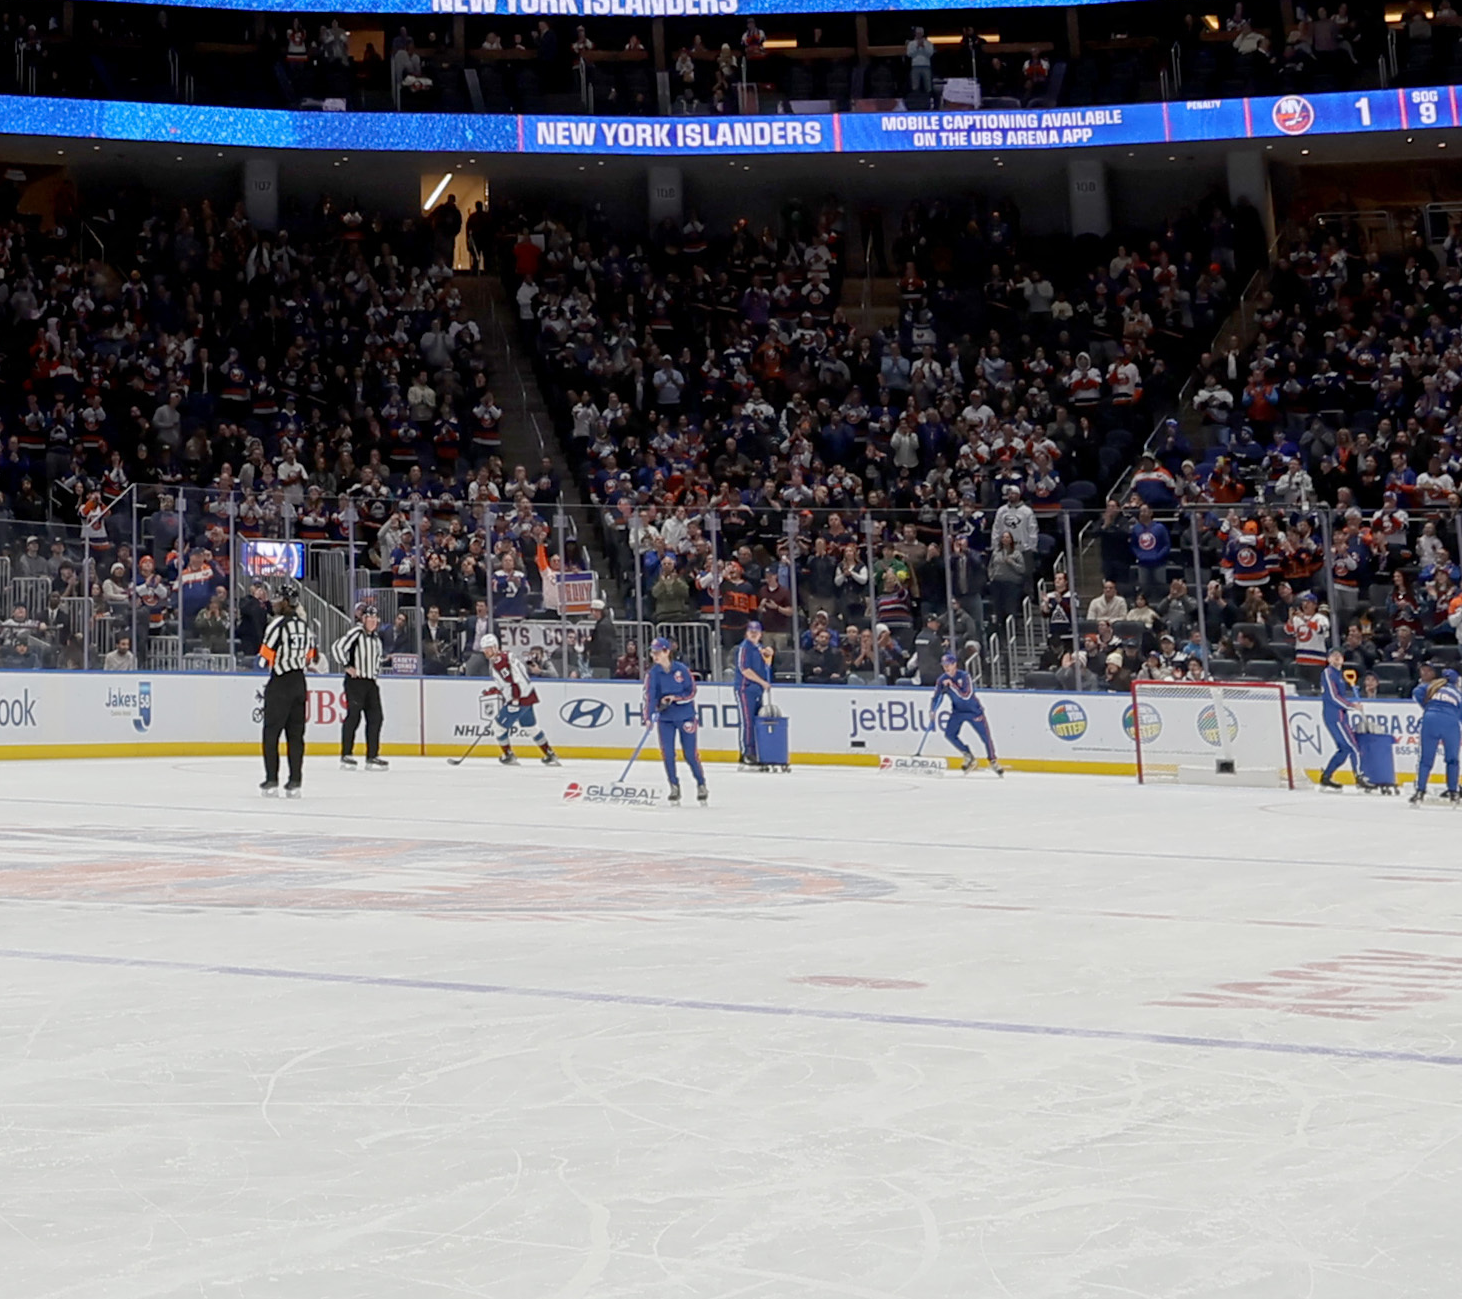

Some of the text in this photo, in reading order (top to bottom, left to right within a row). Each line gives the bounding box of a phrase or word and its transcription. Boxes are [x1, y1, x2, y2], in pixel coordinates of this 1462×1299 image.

[882, 109, 1122, 132] MOBILE CAPTIONING AVAILABLE
[536, 119, 822, 149] NEW YORK ISLANDERS
[913, 127, 1093, 147] ON THE UBS ARENA APP
[105, 687, 137, 709] Jake's
[850, 701, 950, 738] jetBlue
